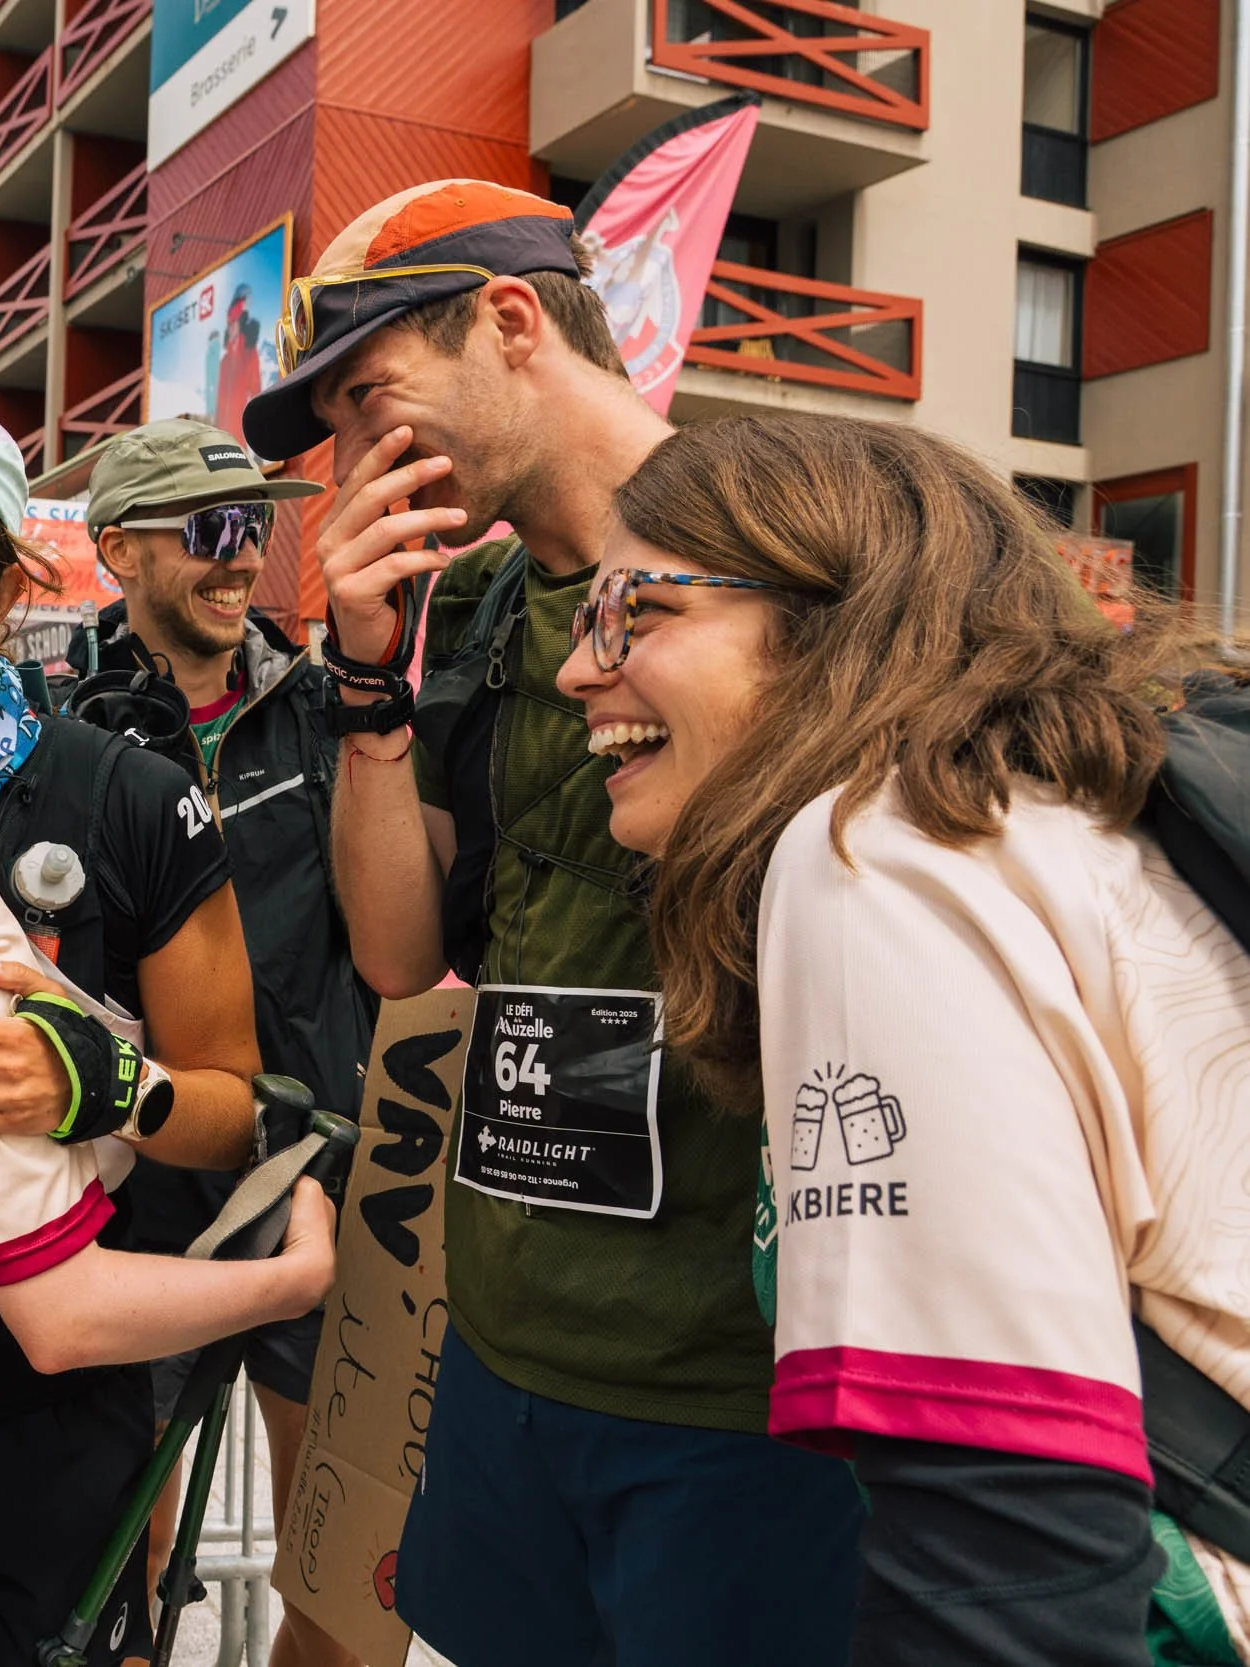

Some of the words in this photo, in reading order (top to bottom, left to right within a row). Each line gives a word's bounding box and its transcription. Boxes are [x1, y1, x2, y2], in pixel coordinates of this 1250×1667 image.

[190, 35, 256, 107] Brasserie
[160, 300, 197, 339] SKISET
[238, 768, 265, 781] KIPRUN
[506, 1004, 515, 1016] LE
[515, 1002, 533, 1017] DÉFI
[591, 1008, 618, 1018] Édition
[619, 1010, 638, 1018] 2025
[495, 1016, 554, 1038] Muzelle
[495, 1041, 551, 1096] 64
[500, 1100, 542, 1121] Pierre
[498, 1136, 591, 1162] RAIDLIGHT
[543, 1178, 578, 1189] Urgence
